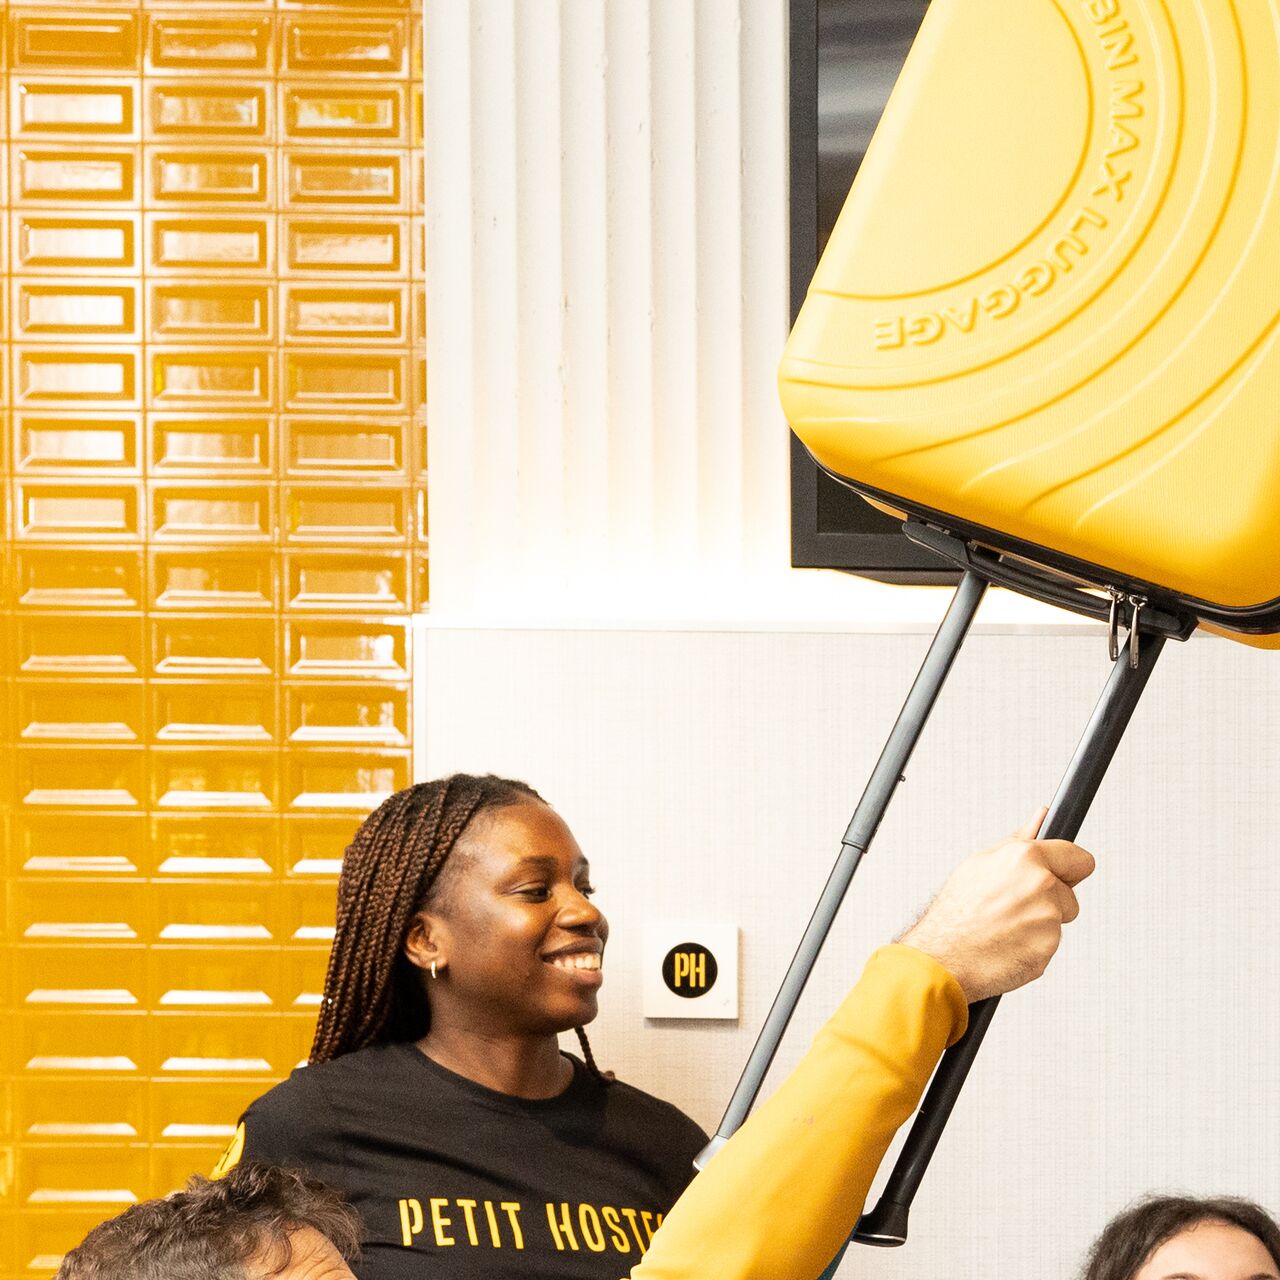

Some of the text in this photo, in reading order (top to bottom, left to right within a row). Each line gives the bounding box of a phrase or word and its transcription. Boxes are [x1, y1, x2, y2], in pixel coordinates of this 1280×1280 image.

[1090, 79, 1146, 203] MAX
[873, 206, 1110, 351] LUGGAGE
[674, 952, 706, 988] PH
[398, 1198, 667, 1256] PETIT HOSTE
